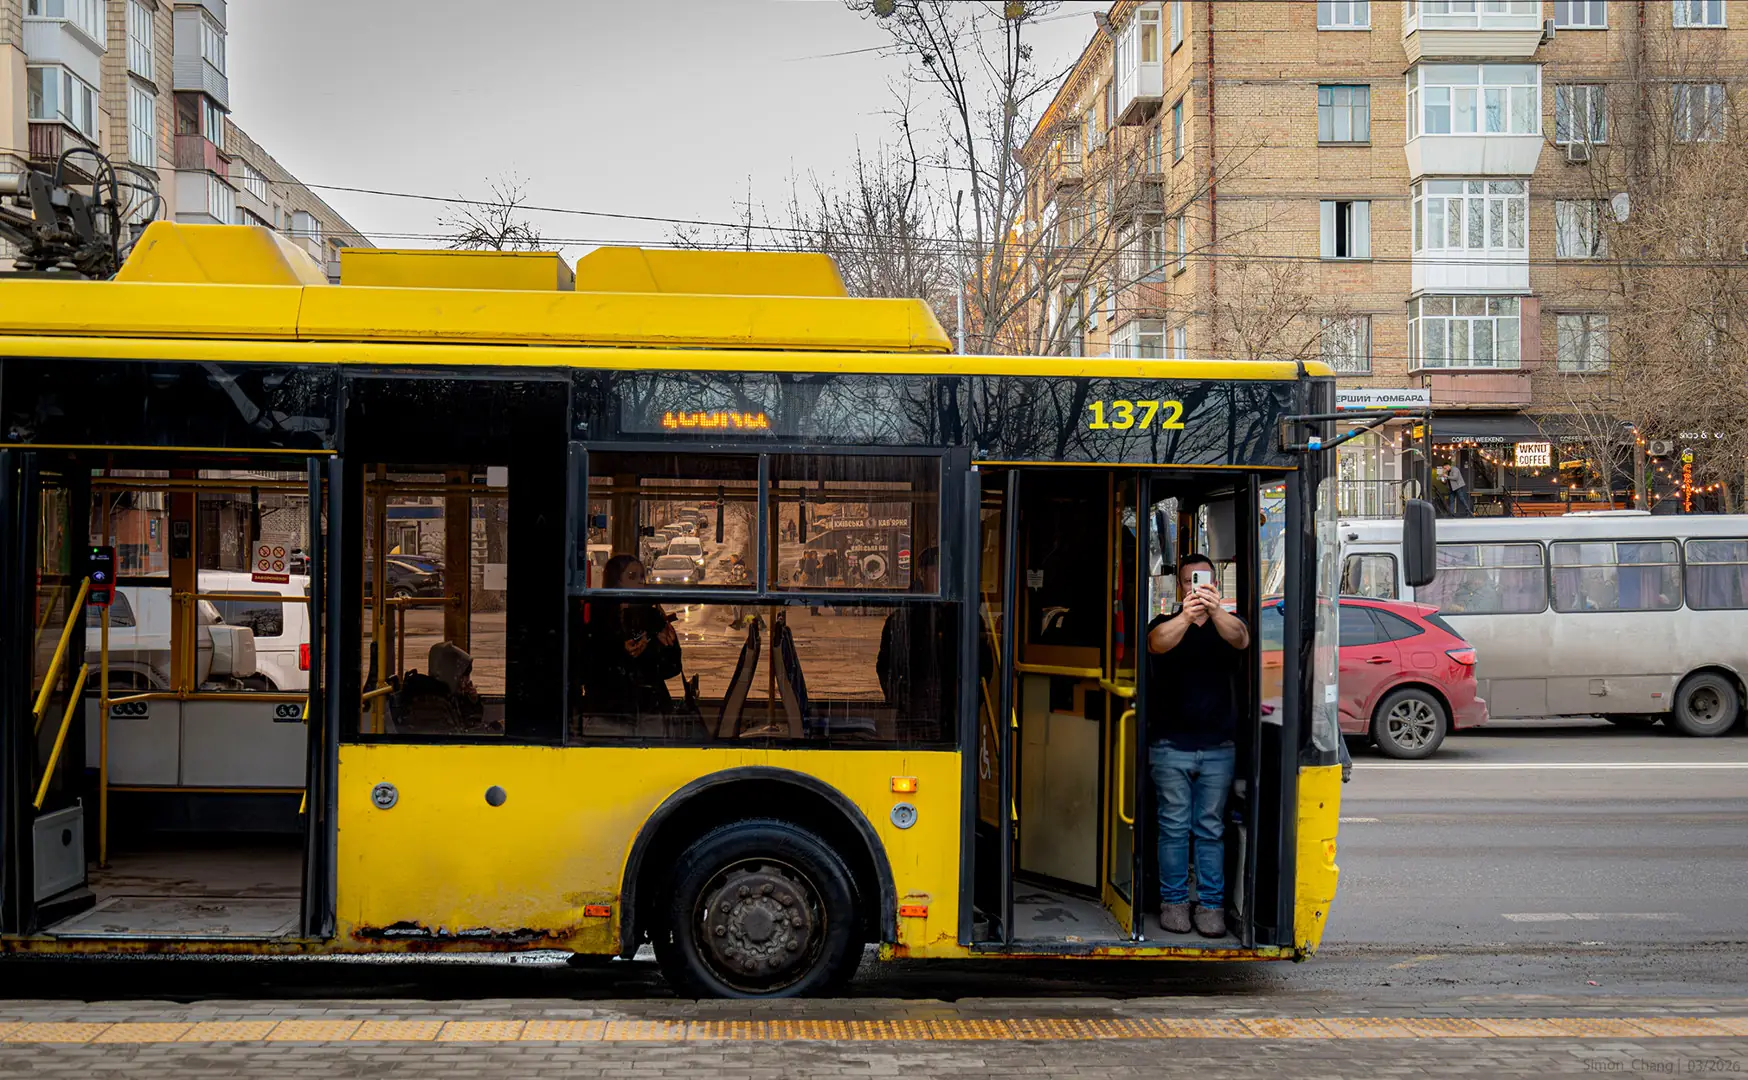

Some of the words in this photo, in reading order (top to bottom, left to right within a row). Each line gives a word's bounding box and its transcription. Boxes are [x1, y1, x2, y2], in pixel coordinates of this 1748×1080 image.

[1336, 394, 1371, 403] ЕРШИЙ
[1376, 394, 1425, 402] ЛОМБАРД
[1088, 400, 1185, 429] 1372
[1519, 444, 1547, 453] WKND
[1519, 455, 1547, 465] COFFEE
